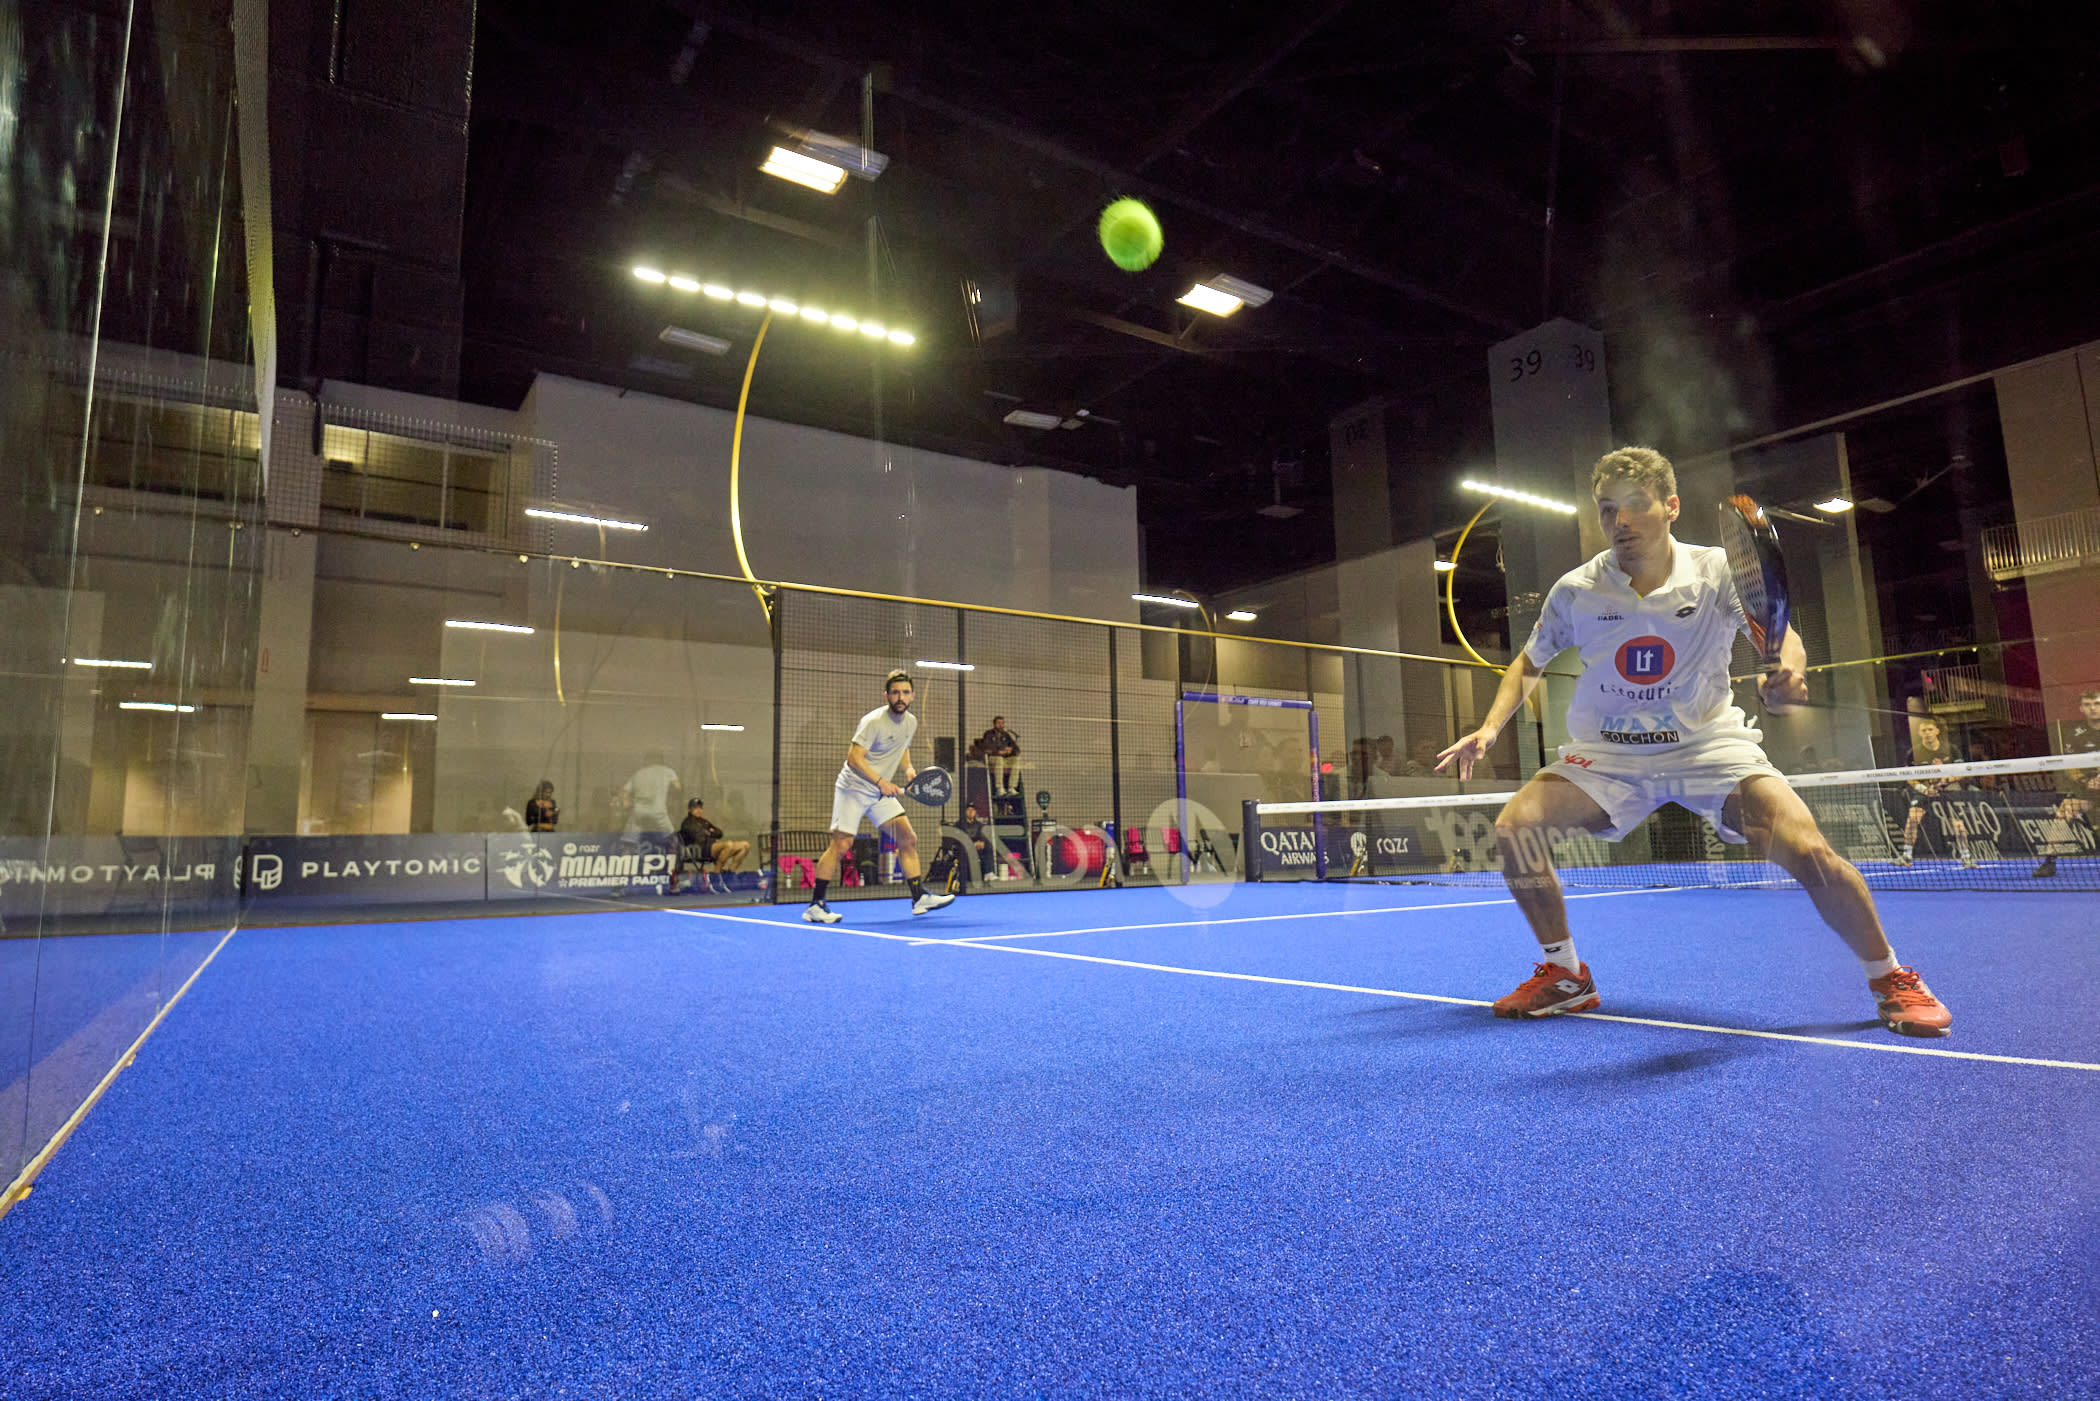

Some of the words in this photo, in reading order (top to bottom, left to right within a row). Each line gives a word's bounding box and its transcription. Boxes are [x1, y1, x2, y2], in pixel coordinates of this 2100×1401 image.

[1510, 349, 1543, 383] 39
[1601, 714, 1674, 732] MAX
[1602, 731, 1679, 744] COLCHON
[559, 855, 640, 878] MIAMI
[642, 853, 677, 876] P1
[1281, 851, 1330, 866] AIRWAS
[301, 858, 481, 878] PLAYTOMIC
[568, 875, 629, 888] PREMIER
